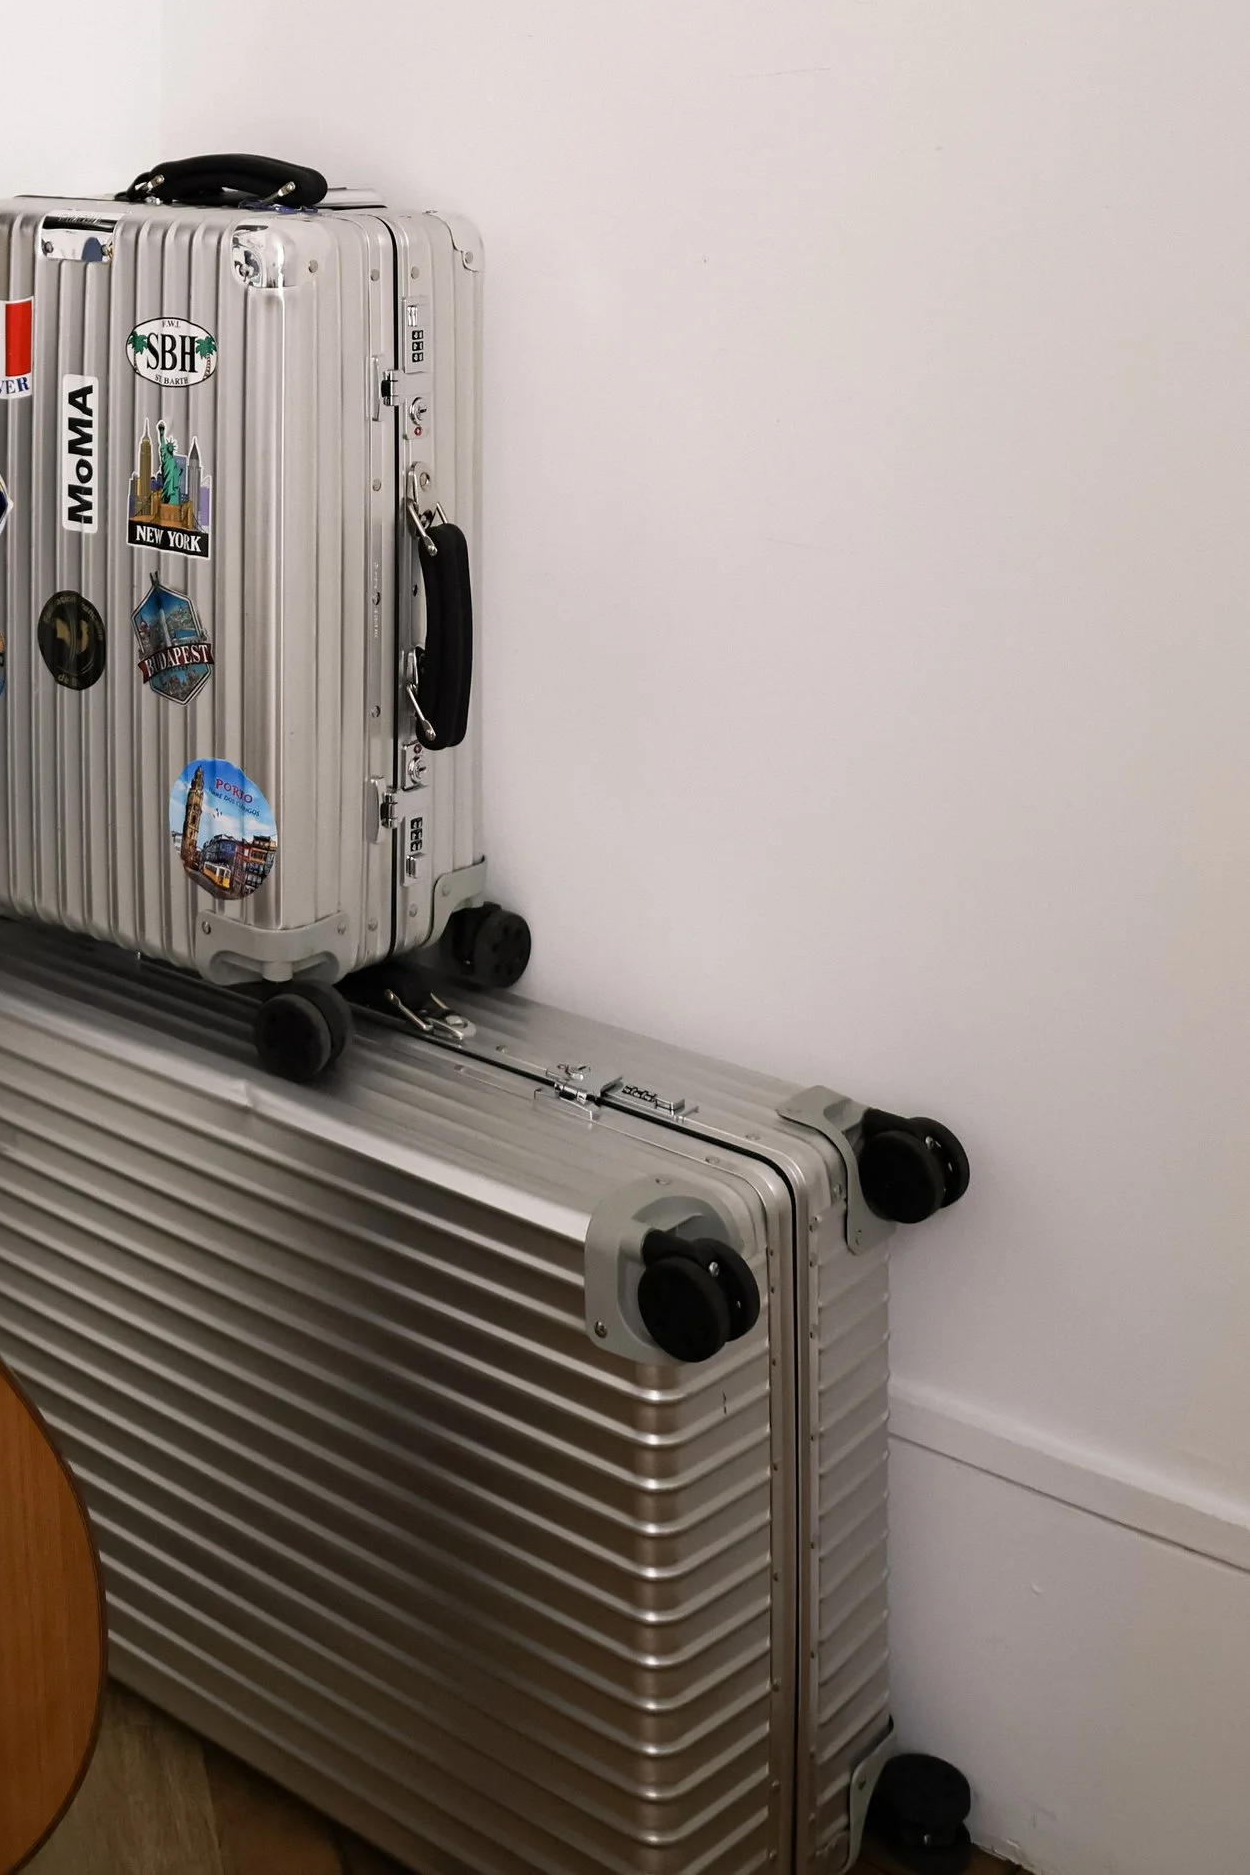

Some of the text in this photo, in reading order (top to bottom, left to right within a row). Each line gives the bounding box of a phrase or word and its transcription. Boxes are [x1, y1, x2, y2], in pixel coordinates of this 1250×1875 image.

[146, 332, 199, 374] SBH
[68, 384, 94, 525] MoMA
[135, 525, 203, 553] NEW YORK
[144, 644, 209, 678] BUDAPEST
[215, 777, 253, 804] PORTO
